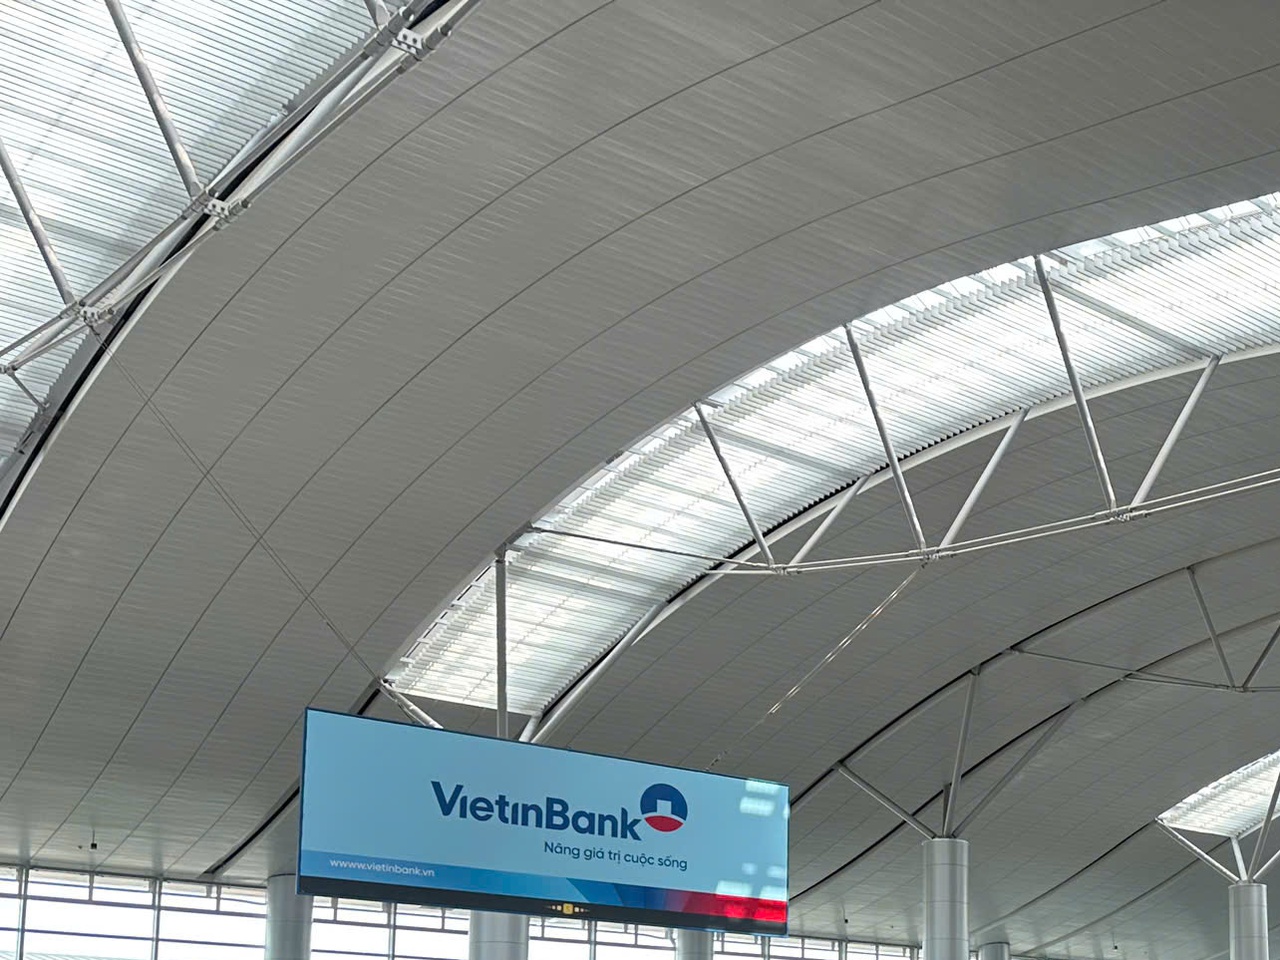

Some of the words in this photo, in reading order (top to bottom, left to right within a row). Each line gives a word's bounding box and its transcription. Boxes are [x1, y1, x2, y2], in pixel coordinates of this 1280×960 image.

[431, 780, 642, 841] VietinBank
[544, 841, 580, 859] Nâng
[583, 847, 605, 860] giá
[608, 850, 621, 864] trị
[623, 853, 655, 867] cuộc
[657, 855, 688, 871] sống
